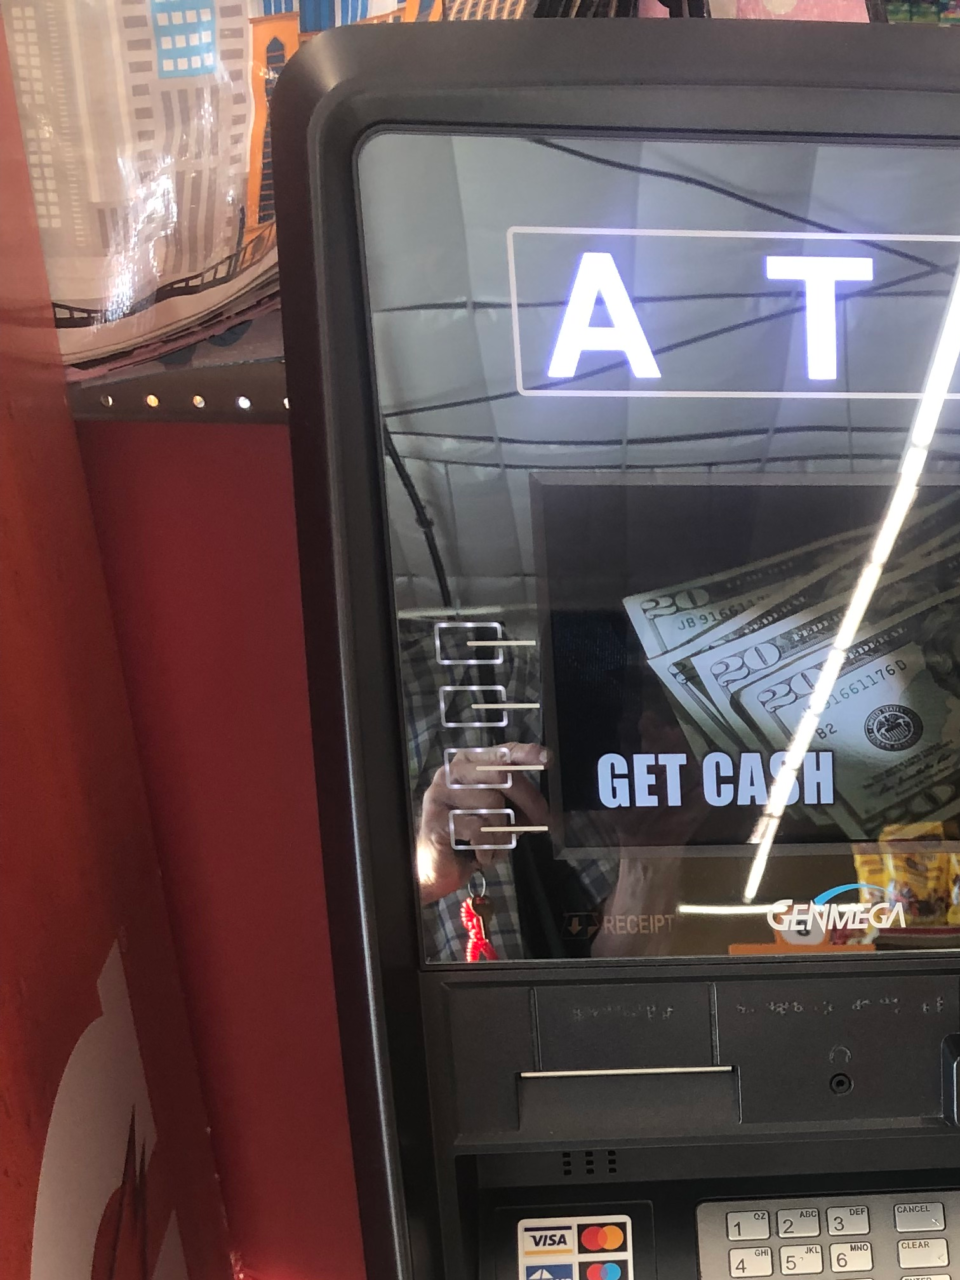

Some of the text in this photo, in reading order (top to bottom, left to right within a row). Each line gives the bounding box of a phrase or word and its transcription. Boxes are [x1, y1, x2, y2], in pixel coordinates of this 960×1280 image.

[709, 641, 782, 687] 20
[596, 753, 687, 809] GET
[702, 751, 835, 807] CASH
[603, 914, 676, 935] RECEIPT
[766, 899, 907, 933] GENMEGA
[833, 1208, 866, 1231] 3 DEF
[896, 1204, 931, 1214] CANCEL
[733, 1212, 767, 1236] 1 QZ
[782, 1210, 817, 1234] 2 ABC
[529, 1233, 568, 1247] VISA
[901, 1240, 930, 1250] CLEAR
[735, 1249, 769, 1274] 4 GHI
[785, 1246, 820, 1271] 5 JKL
[835, 1243, 869, 1268] 6 MNO
